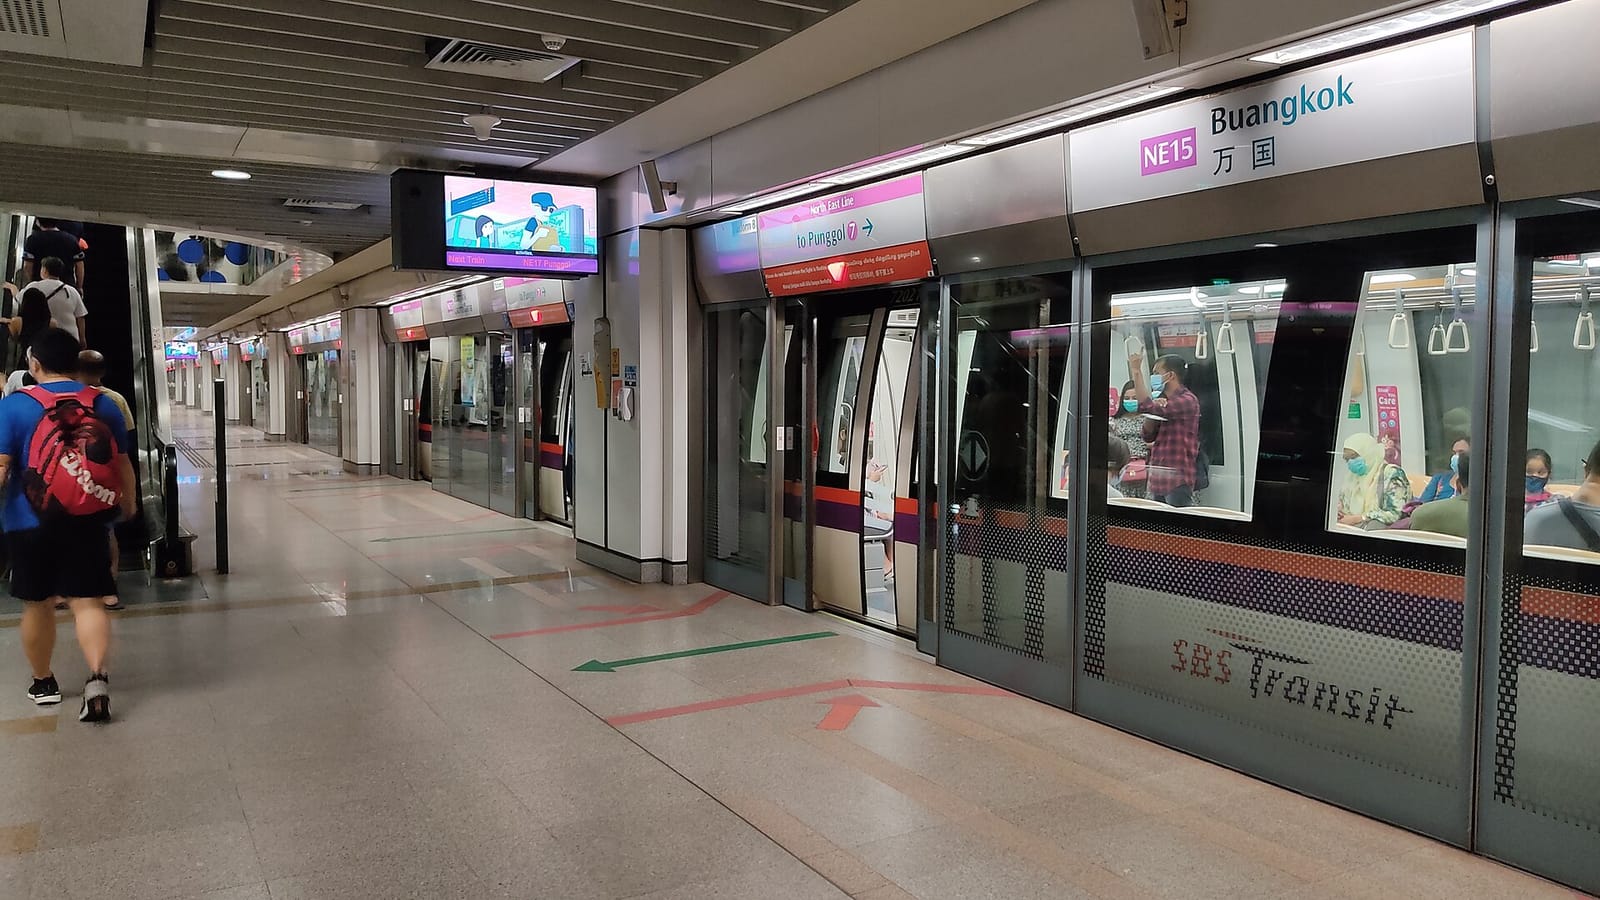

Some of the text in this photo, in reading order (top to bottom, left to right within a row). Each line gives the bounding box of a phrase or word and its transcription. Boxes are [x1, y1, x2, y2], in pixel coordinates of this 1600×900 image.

[1211, 74, 1354, 135] Buangkok
[1143, 136, 1193, 168] NE15
[1213, 136, 1275, 176] 万国
[810, 196, 854, 215] North East Line
[797, 234, 806, 248] to
[808, 223, 846, 247] Punggol
[448, 255, 571, 270] Next Train NE17 Punggol
[1378, 397, 1396, 405] Care
[1171, 639, 1414, 730] SBS Transit
